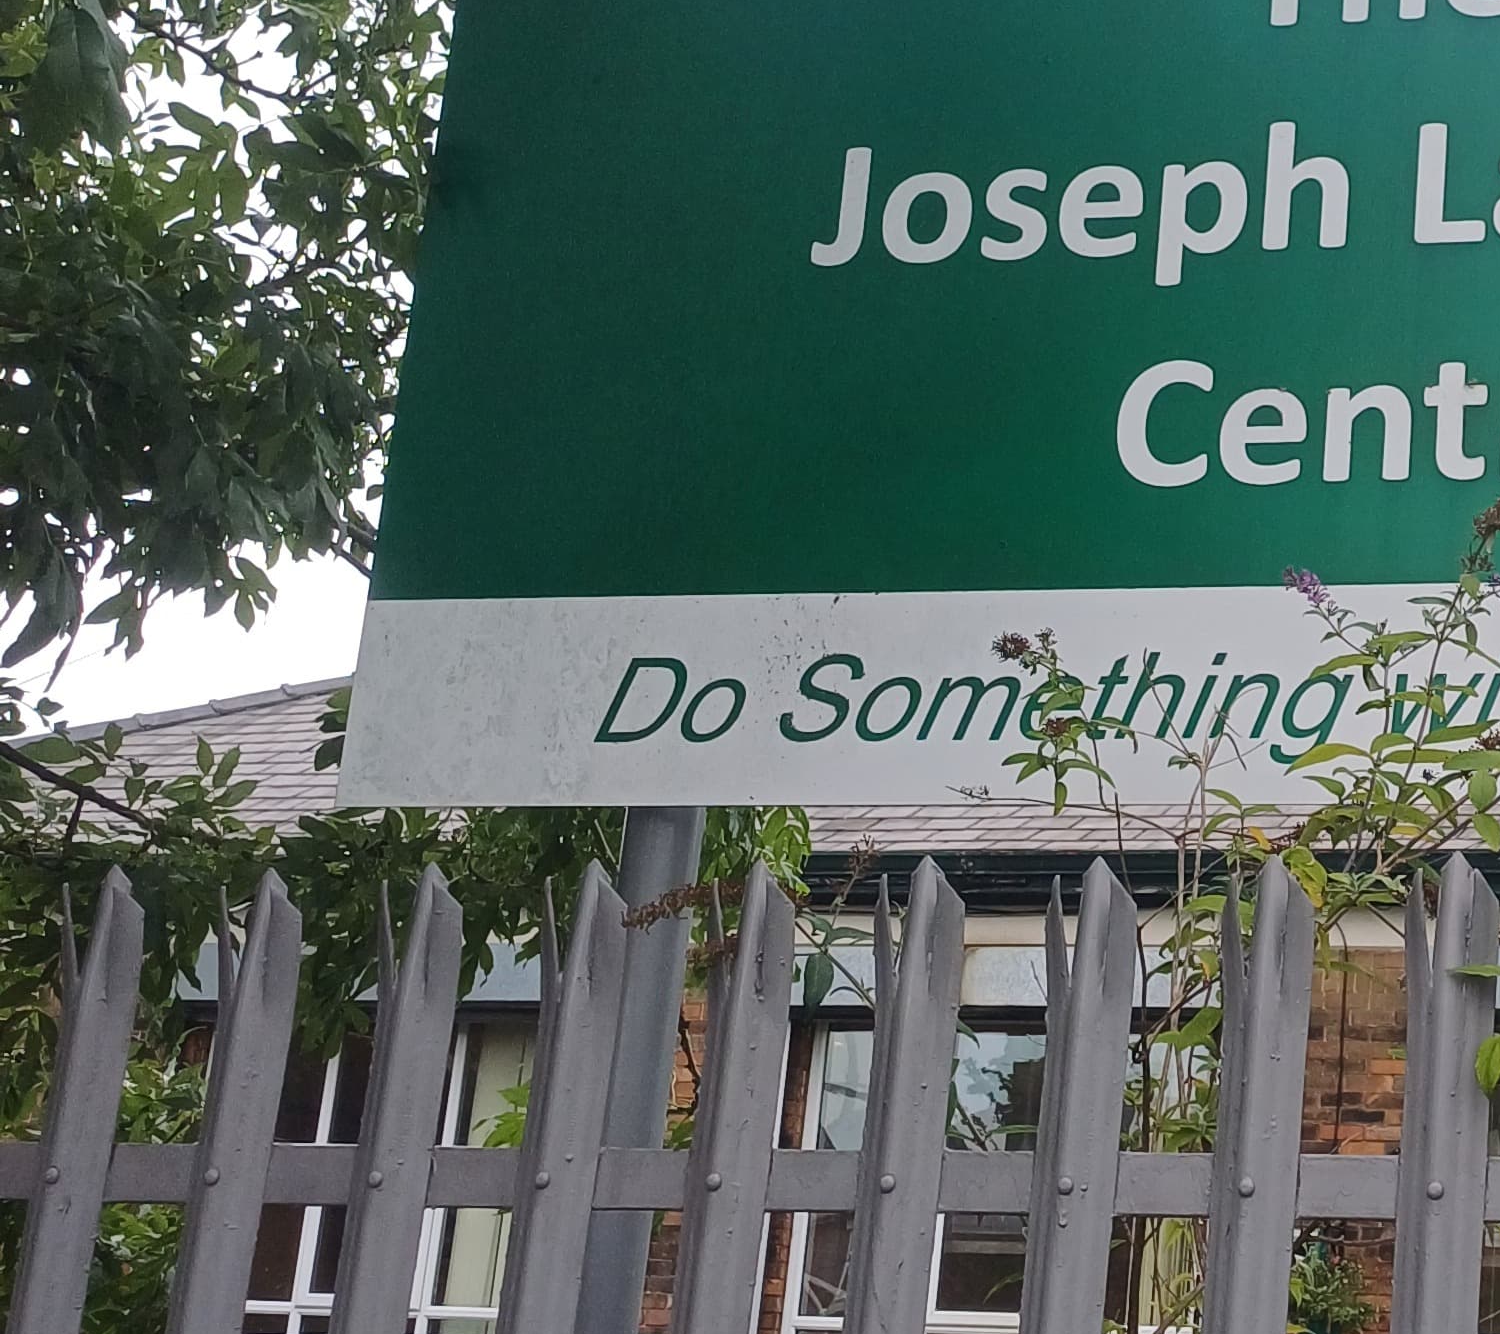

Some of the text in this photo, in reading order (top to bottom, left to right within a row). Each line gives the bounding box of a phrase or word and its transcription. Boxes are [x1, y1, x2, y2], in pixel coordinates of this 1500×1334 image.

[810, 120, 1351, 287] Joseph
[594, 656, 748, 744] Do
[779, 651, 1352, 765] Something
